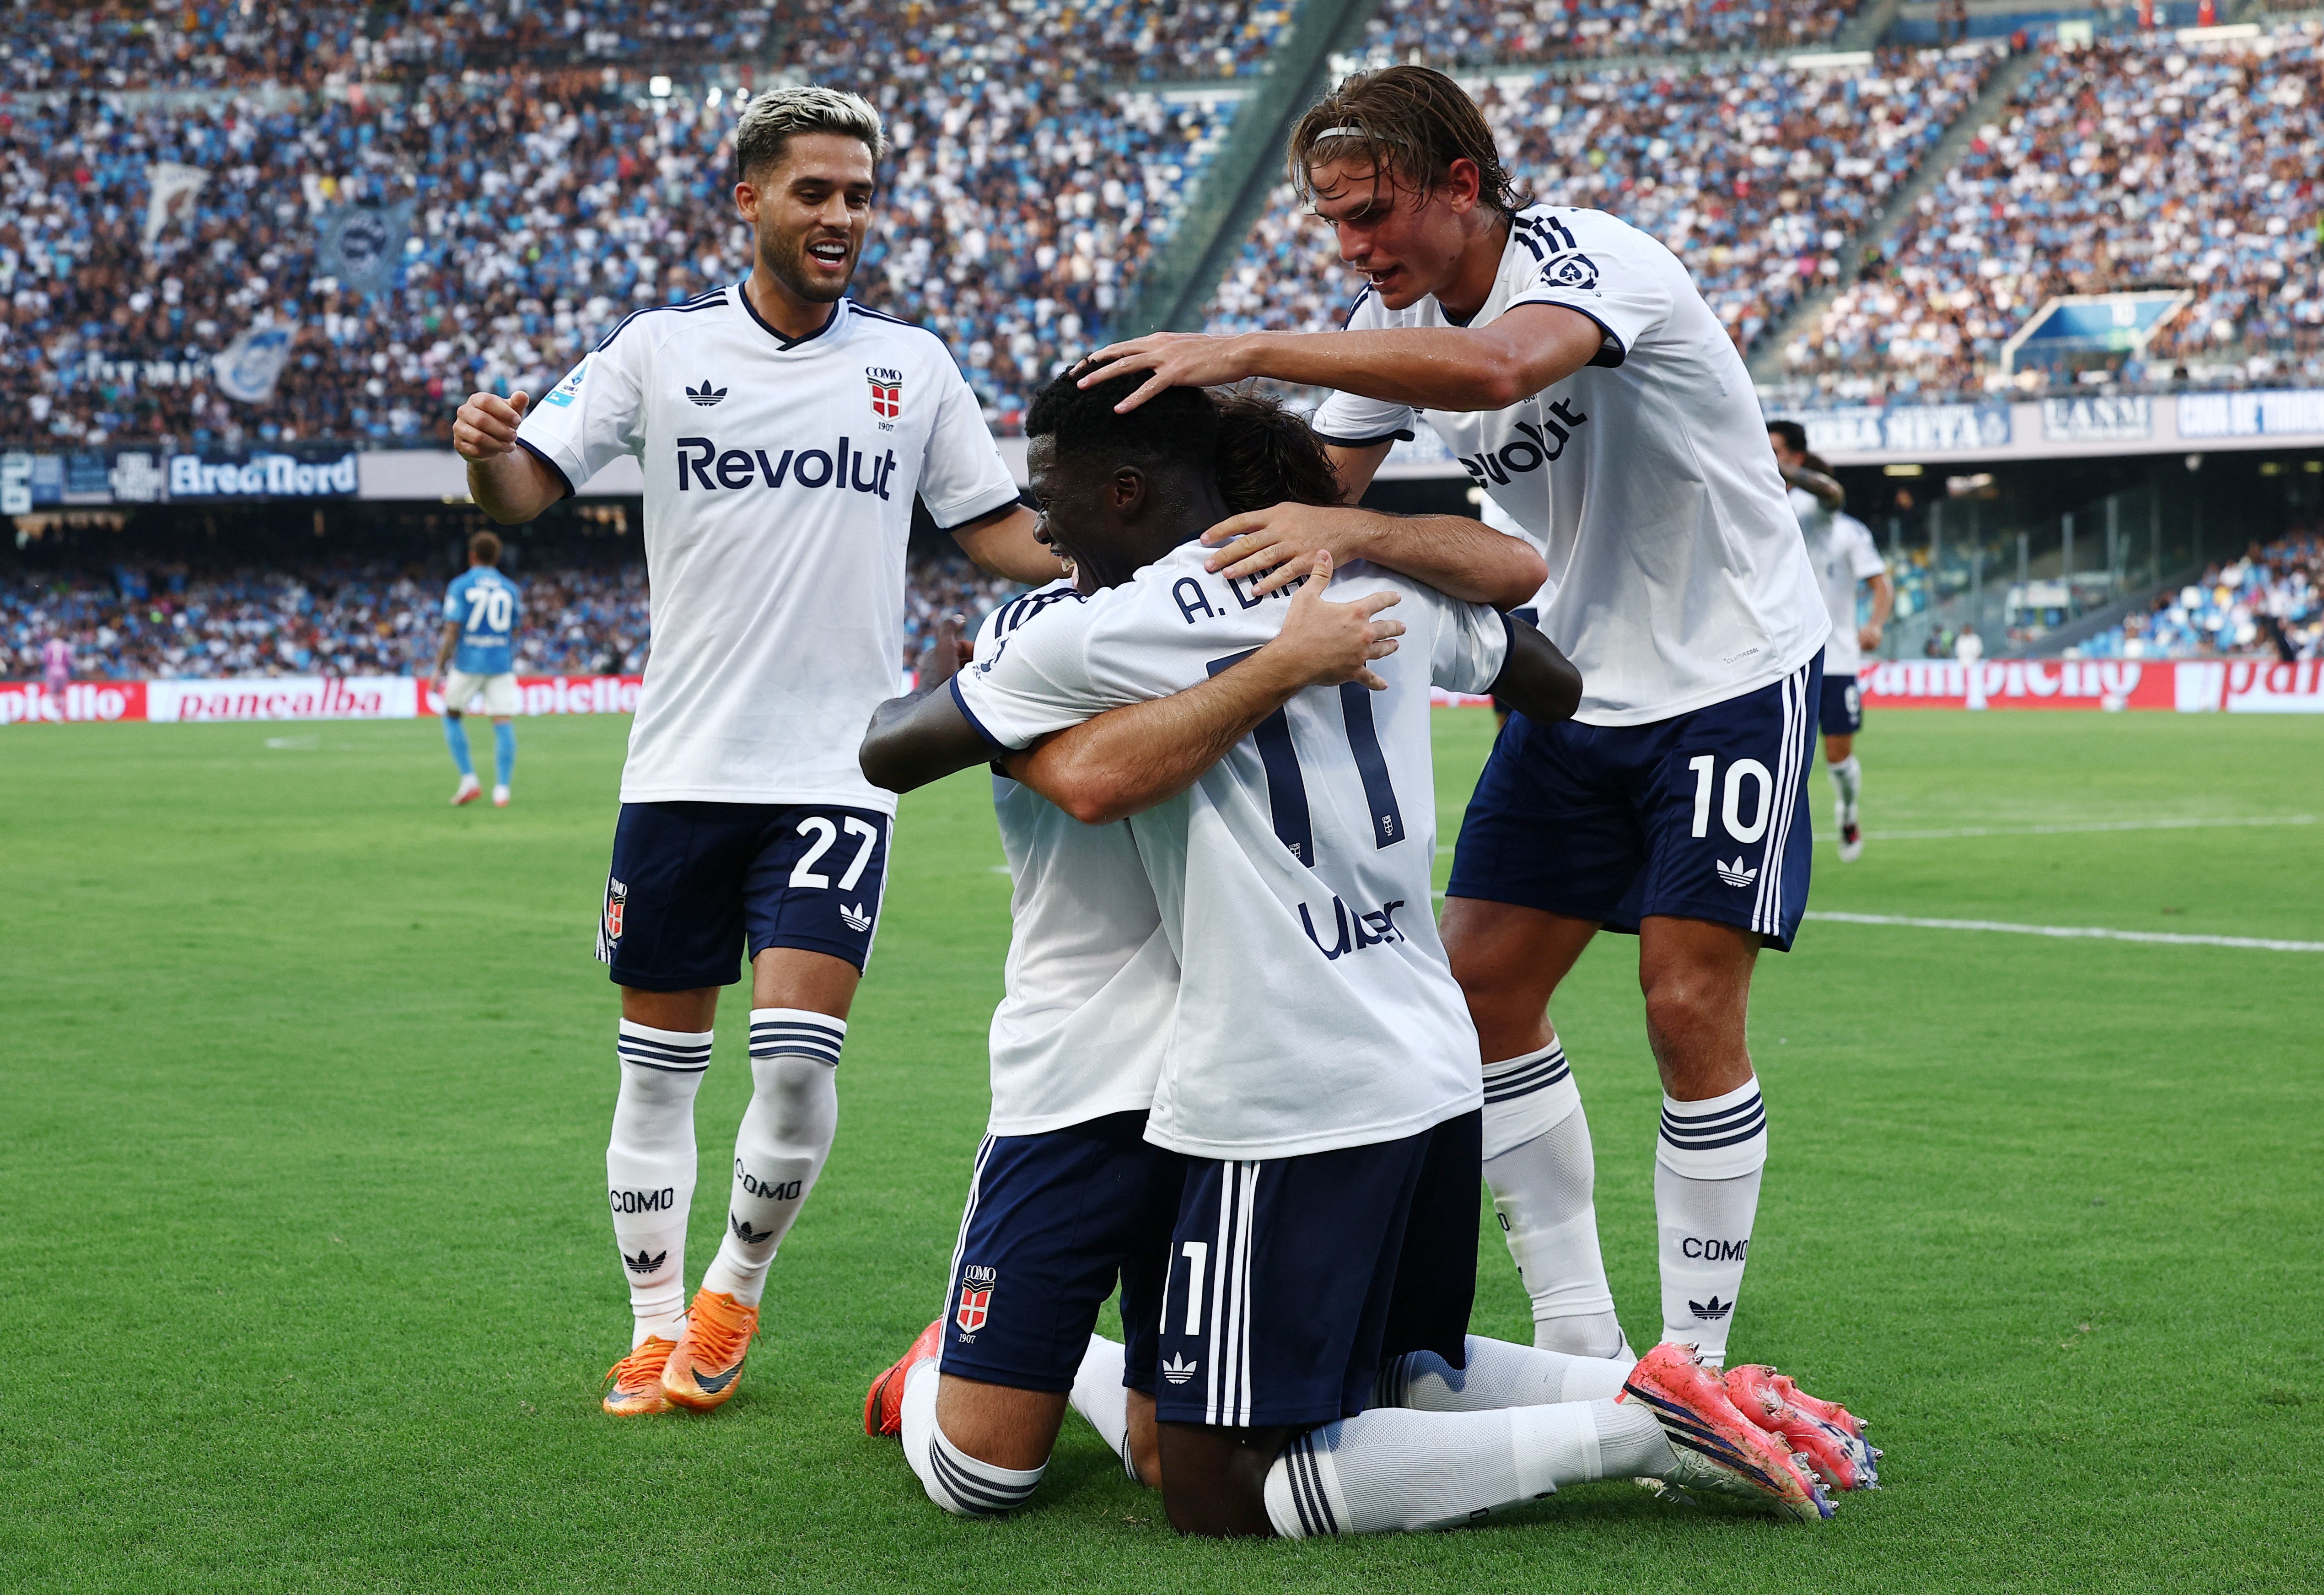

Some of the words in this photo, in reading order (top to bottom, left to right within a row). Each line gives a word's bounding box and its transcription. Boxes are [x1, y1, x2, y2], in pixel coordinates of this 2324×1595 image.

[866, 366, 902, 381] COMO
[878, 421, 894, 431] 1907
[1457, 397, 1587, 489] evolut
[677, 436, 897, 501] Revolut
[465, 587, 514, 632] 70
[1172, 577, 1226, 625] A.
[1726, 647, 1759, 664] CLIMACOOL
[1688, 754, 1773, 844] 10
[788, 816, 878, 891] 27
[610, 1187, 674, 1213] COMO
[735, 1158, 802, 1201] COMO
[965, 1264, 996, 1282] COMO
[958, 1333, 976, 1344] 1907
